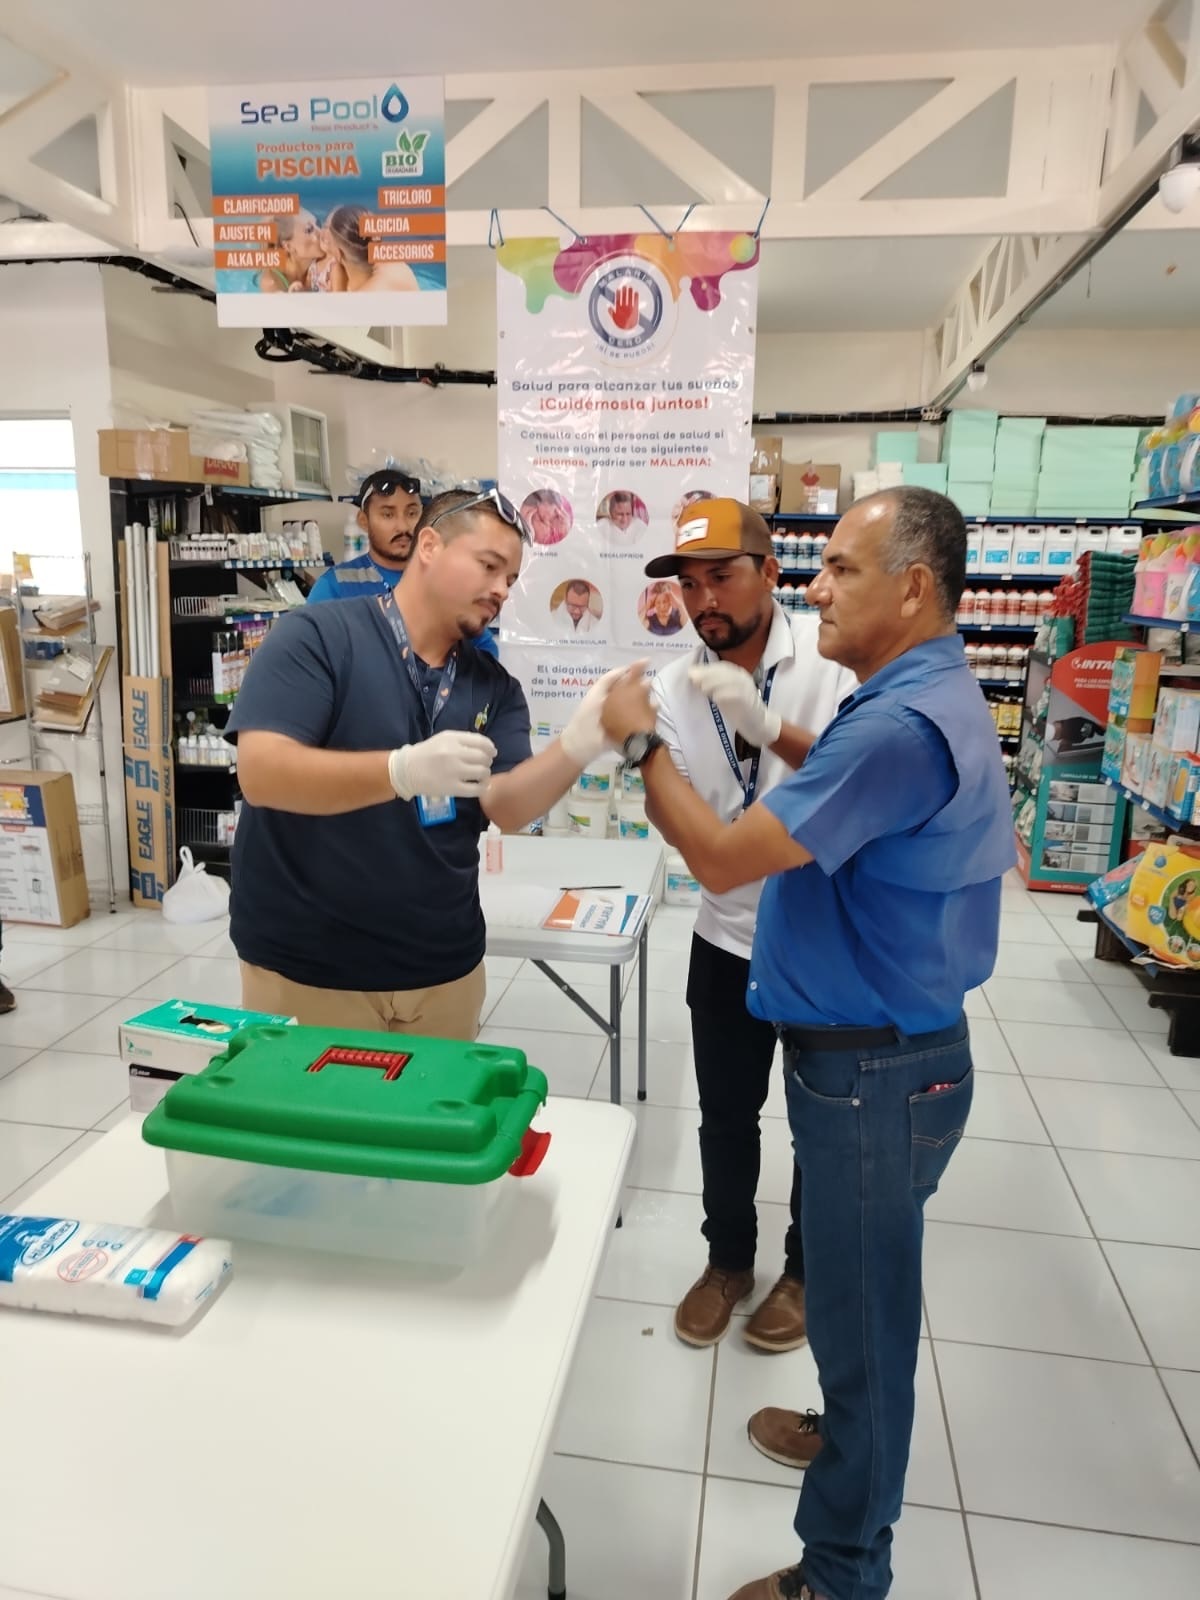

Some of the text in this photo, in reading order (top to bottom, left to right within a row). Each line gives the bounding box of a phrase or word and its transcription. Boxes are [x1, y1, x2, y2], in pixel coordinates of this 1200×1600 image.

[240, 94, 378, 124] Sea Pool
[256, 142, 354, 153] Productos para
[257, 155, 360, 179] PISCINA
[385, 154, 417, 166] BIO
[383, 189, 432, 205] TRICLORO
[223, 199, 294, 214] CLARIFICADOR
[364, 218, 410, 233] ALGICIDA
[219, 226, 271, 241] AJUSTE PH
[227, 252, 280, 267] ALKA PLUS
[373, 244, 434, 260] ACCESORIOS
[511, 378, 739, 394] Salud para alcanzar tus sueños
[540, 396, 708, 413] ¡Cuidémosla juntos!
[520, 429, 724, 442] Consulta con el personal de salud si
[535, 444, 570, 453] tienes
[614, 445, 627, 453] de
[631, 445, 648, 453] los
[651, 444, 708, 455] siguientes
[537, 665, 548, 673] El
[531, 677, 597, 686] de la MALA
[531, 690, 577, 698] importar
[132, 687, 148, 750] EAGLE
[136, 800, 153, 860] EAGLE
